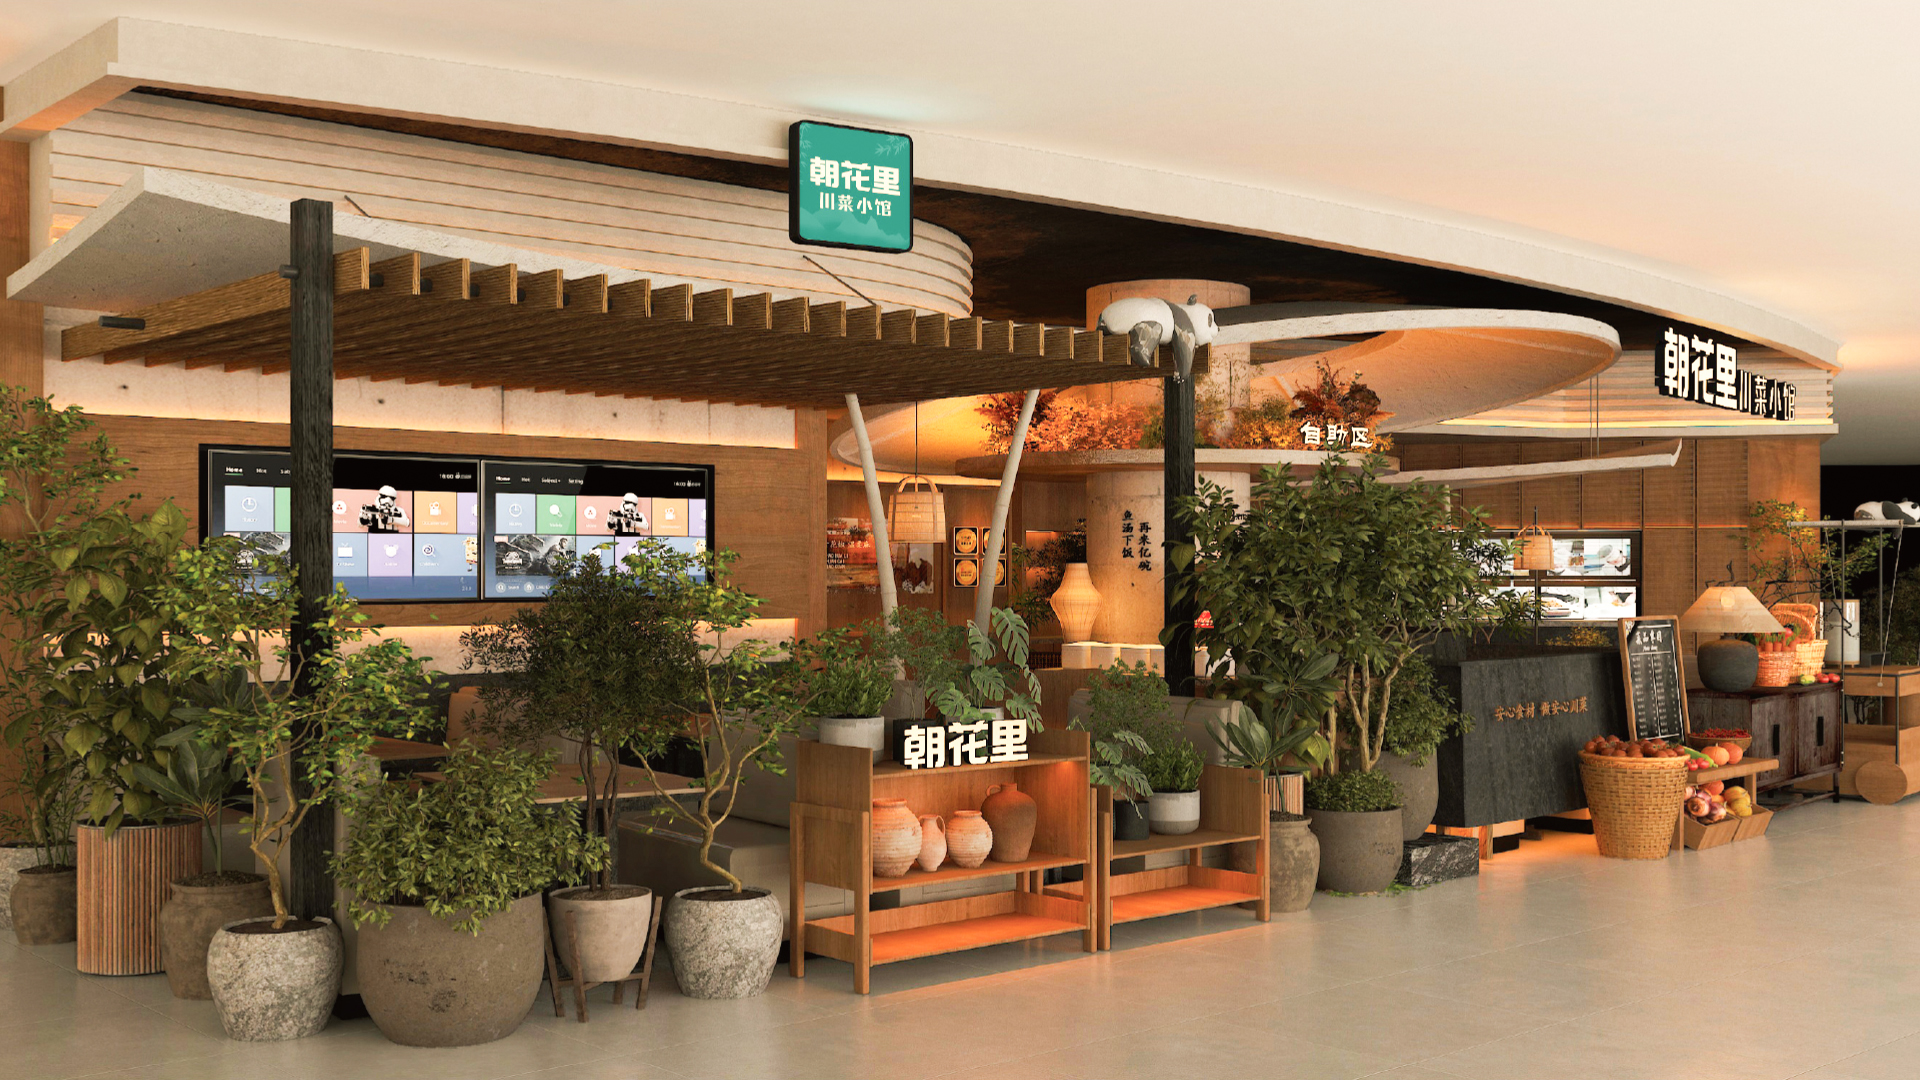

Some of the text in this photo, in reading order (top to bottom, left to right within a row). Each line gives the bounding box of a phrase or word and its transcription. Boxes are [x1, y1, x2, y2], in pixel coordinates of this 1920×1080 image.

[810, 156, 901, 196] 朝花里
[820, 192, 892, 217] 川菜小馆
[1664, 327, 1796, 421] 朝花里 川菜小馆
[1300, 421, 1373, 448] 自助区
[1122, 509, 1135, 559] 鱼汤下饭
[1138, 521, 1152, 571] 再来亿碗
[1494, 703, 1536, 721] 安心食材
[904, 718, 1029, 770] 朝花里
